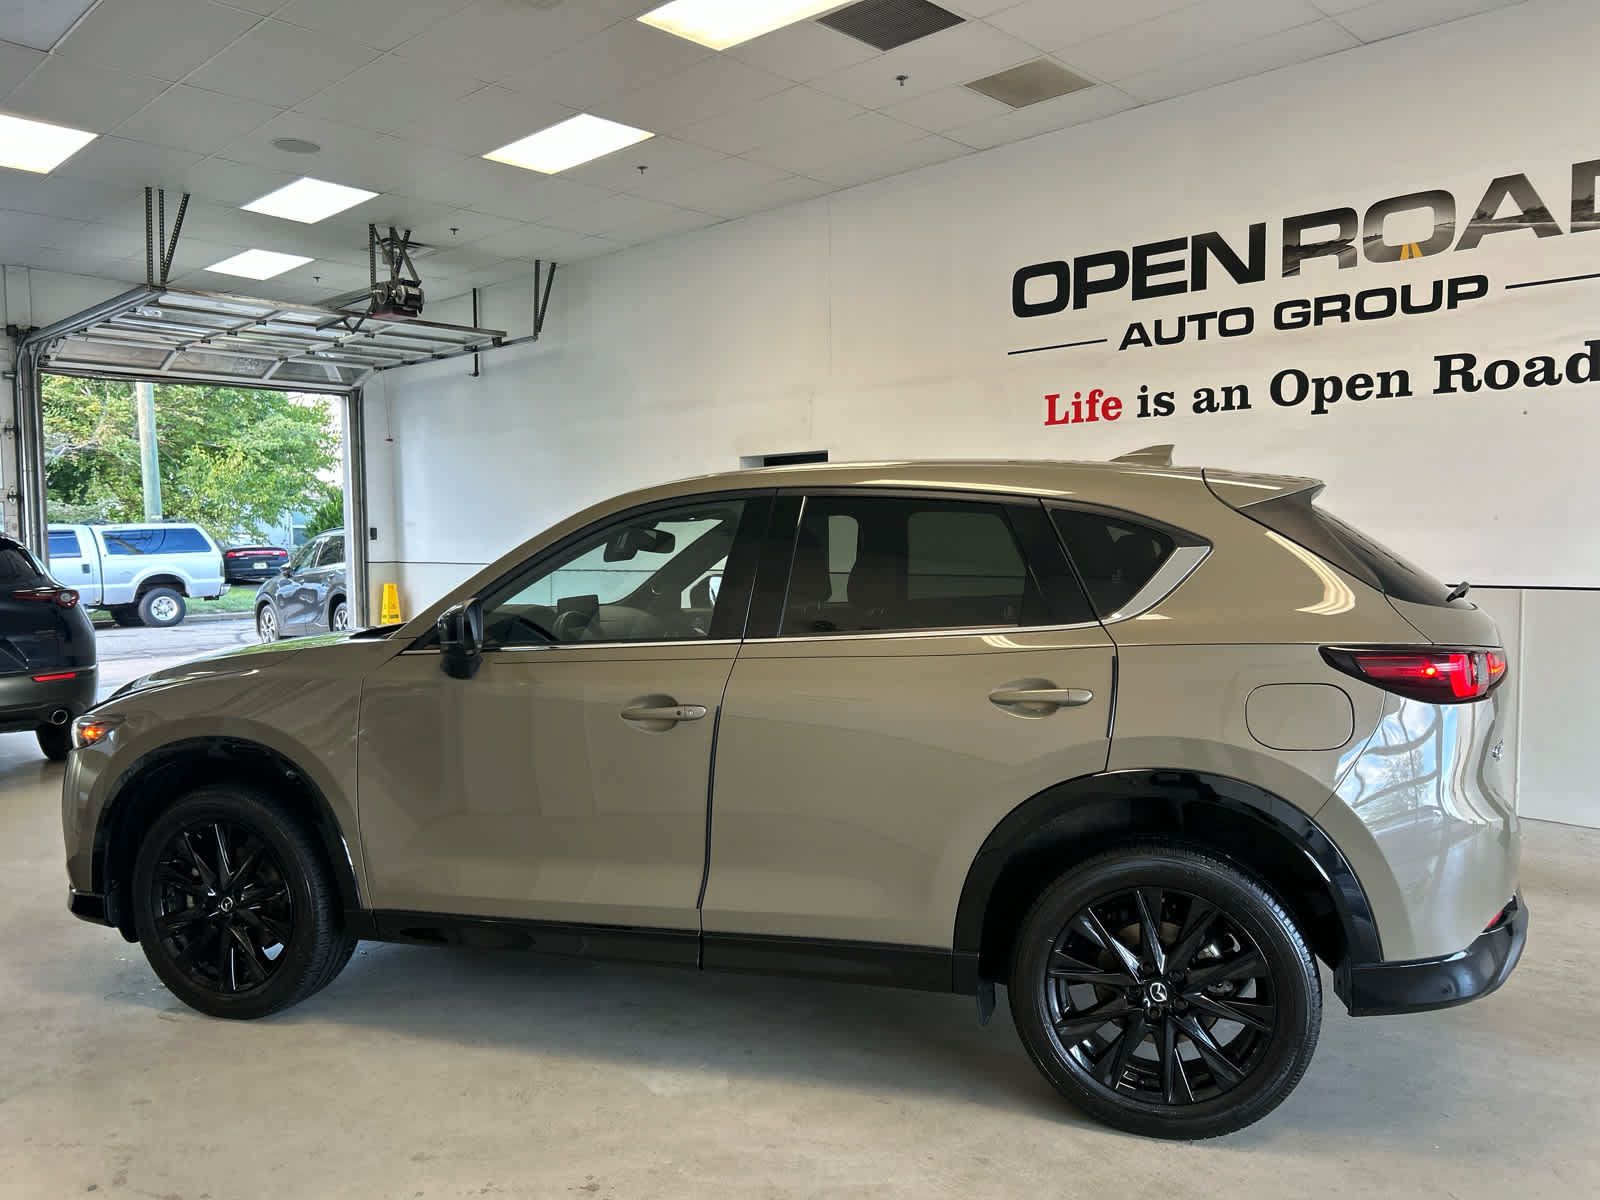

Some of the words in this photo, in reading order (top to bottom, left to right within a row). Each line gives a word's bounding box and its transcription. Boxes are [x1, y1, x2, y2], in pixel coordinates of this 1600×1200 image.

[1011, 221, 1267, 319] OPEN
[1117, 306, 1255, 352] AUTO
[1273, 274, 1489, 331] GROUP
[1044, 388, 1123, 427] Life
[1136, 384, 1176, 419] is
[1192, 384, 1252, 414] an
[1269, 368, 1413, 416] Open
